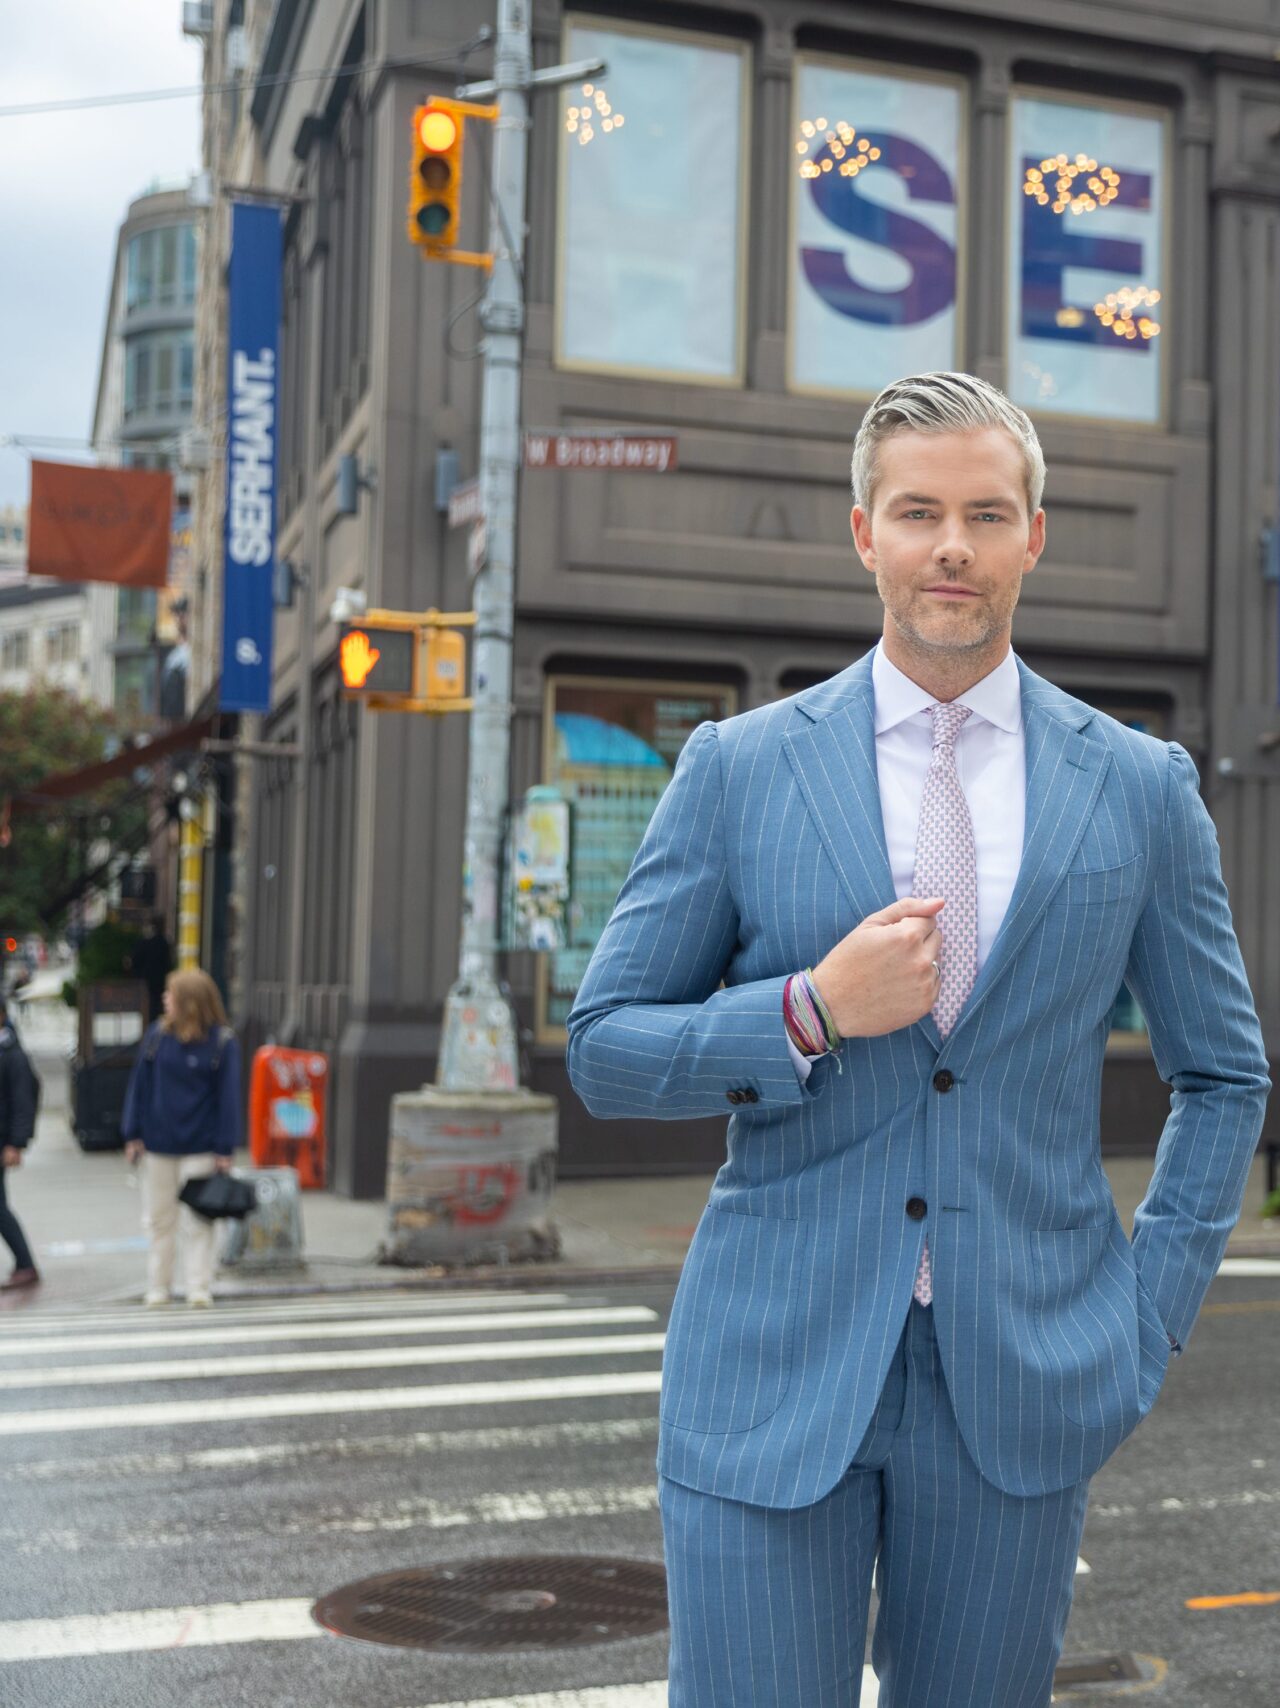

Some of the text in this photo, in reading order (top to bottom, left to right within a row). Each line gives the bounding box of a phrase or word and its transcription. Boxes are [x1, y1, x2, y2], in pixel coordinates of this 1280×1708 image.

[229, 347, 275, 567] SERHANT.
[526, 436, 671, 472] W Broadway
